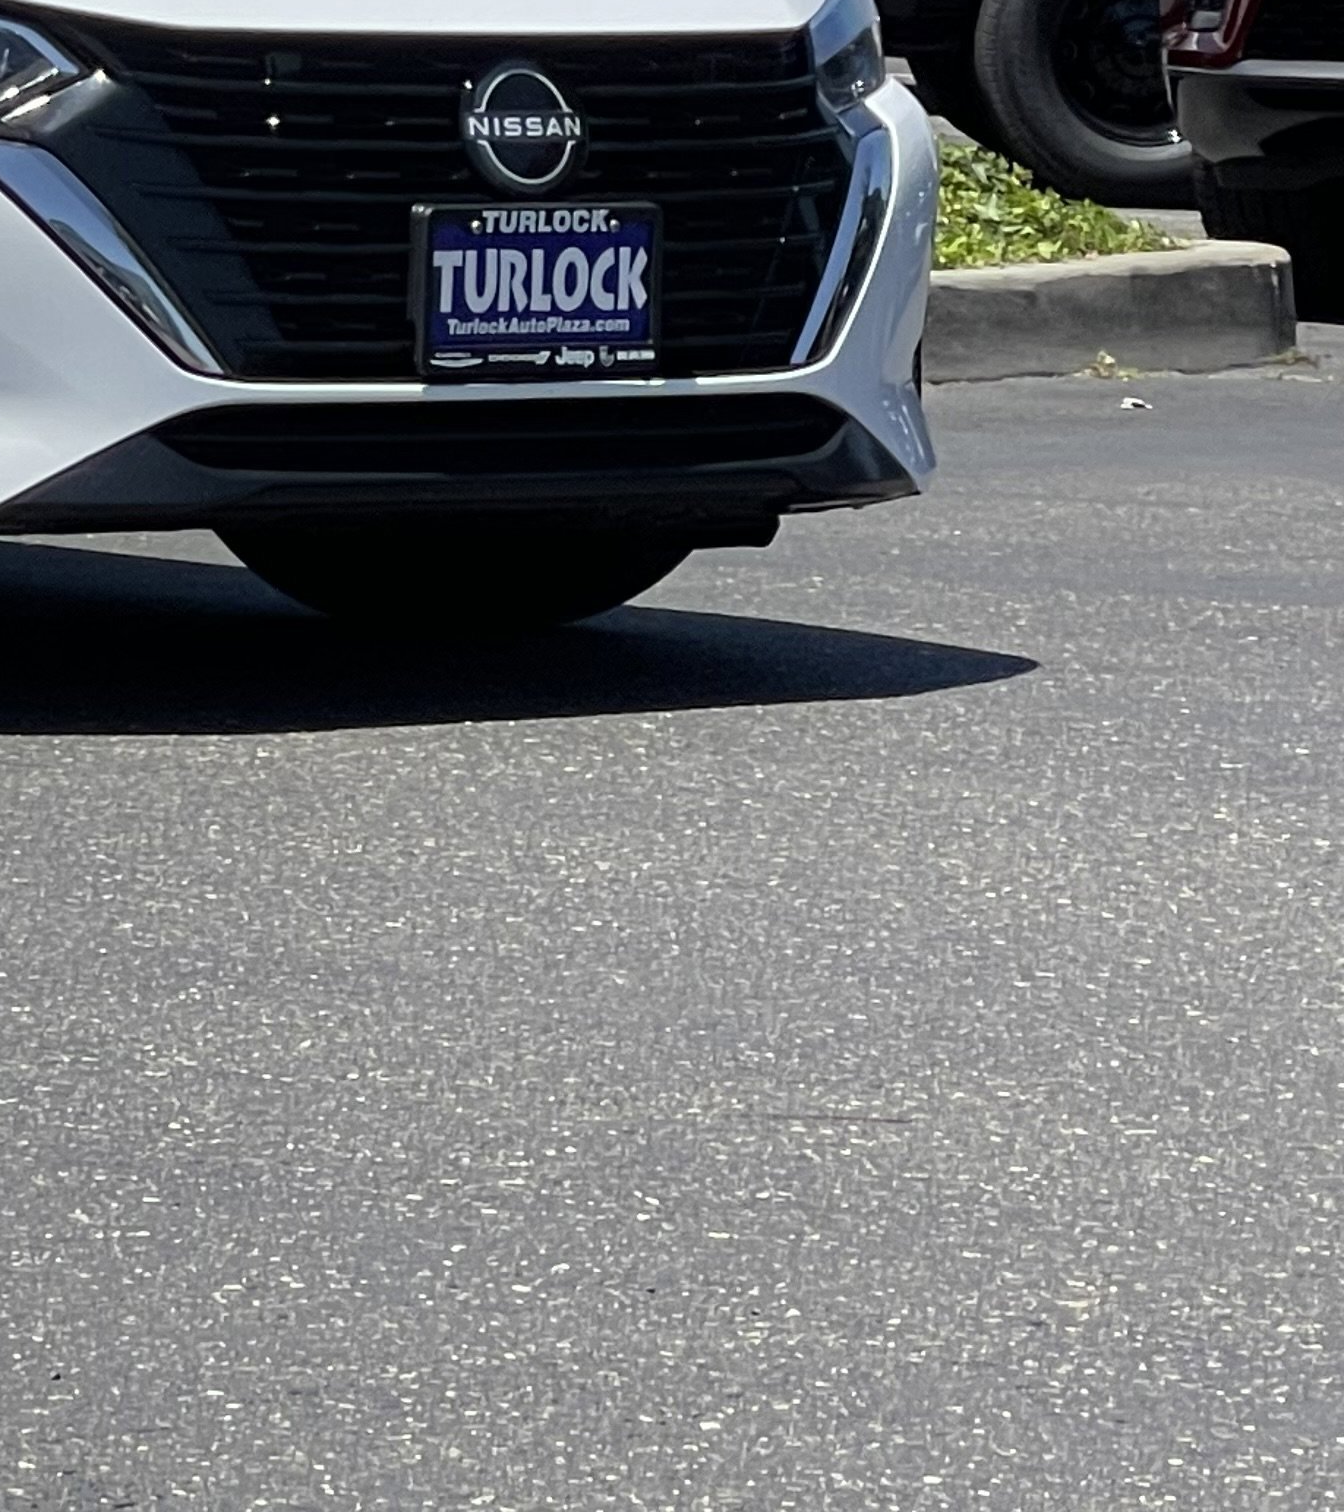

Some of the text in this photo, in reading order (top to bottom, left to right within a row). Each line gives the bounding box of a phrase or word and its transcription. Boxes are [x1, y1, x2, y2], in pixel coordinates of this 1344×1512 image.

[468, 116, 581, 137] NISSAN
[482, 209, 609, 233] TURLOCK
[432, 246, 648, 313] TURLOCK
[447, 316, 630, 335] TurlockAutoPlaza.com
